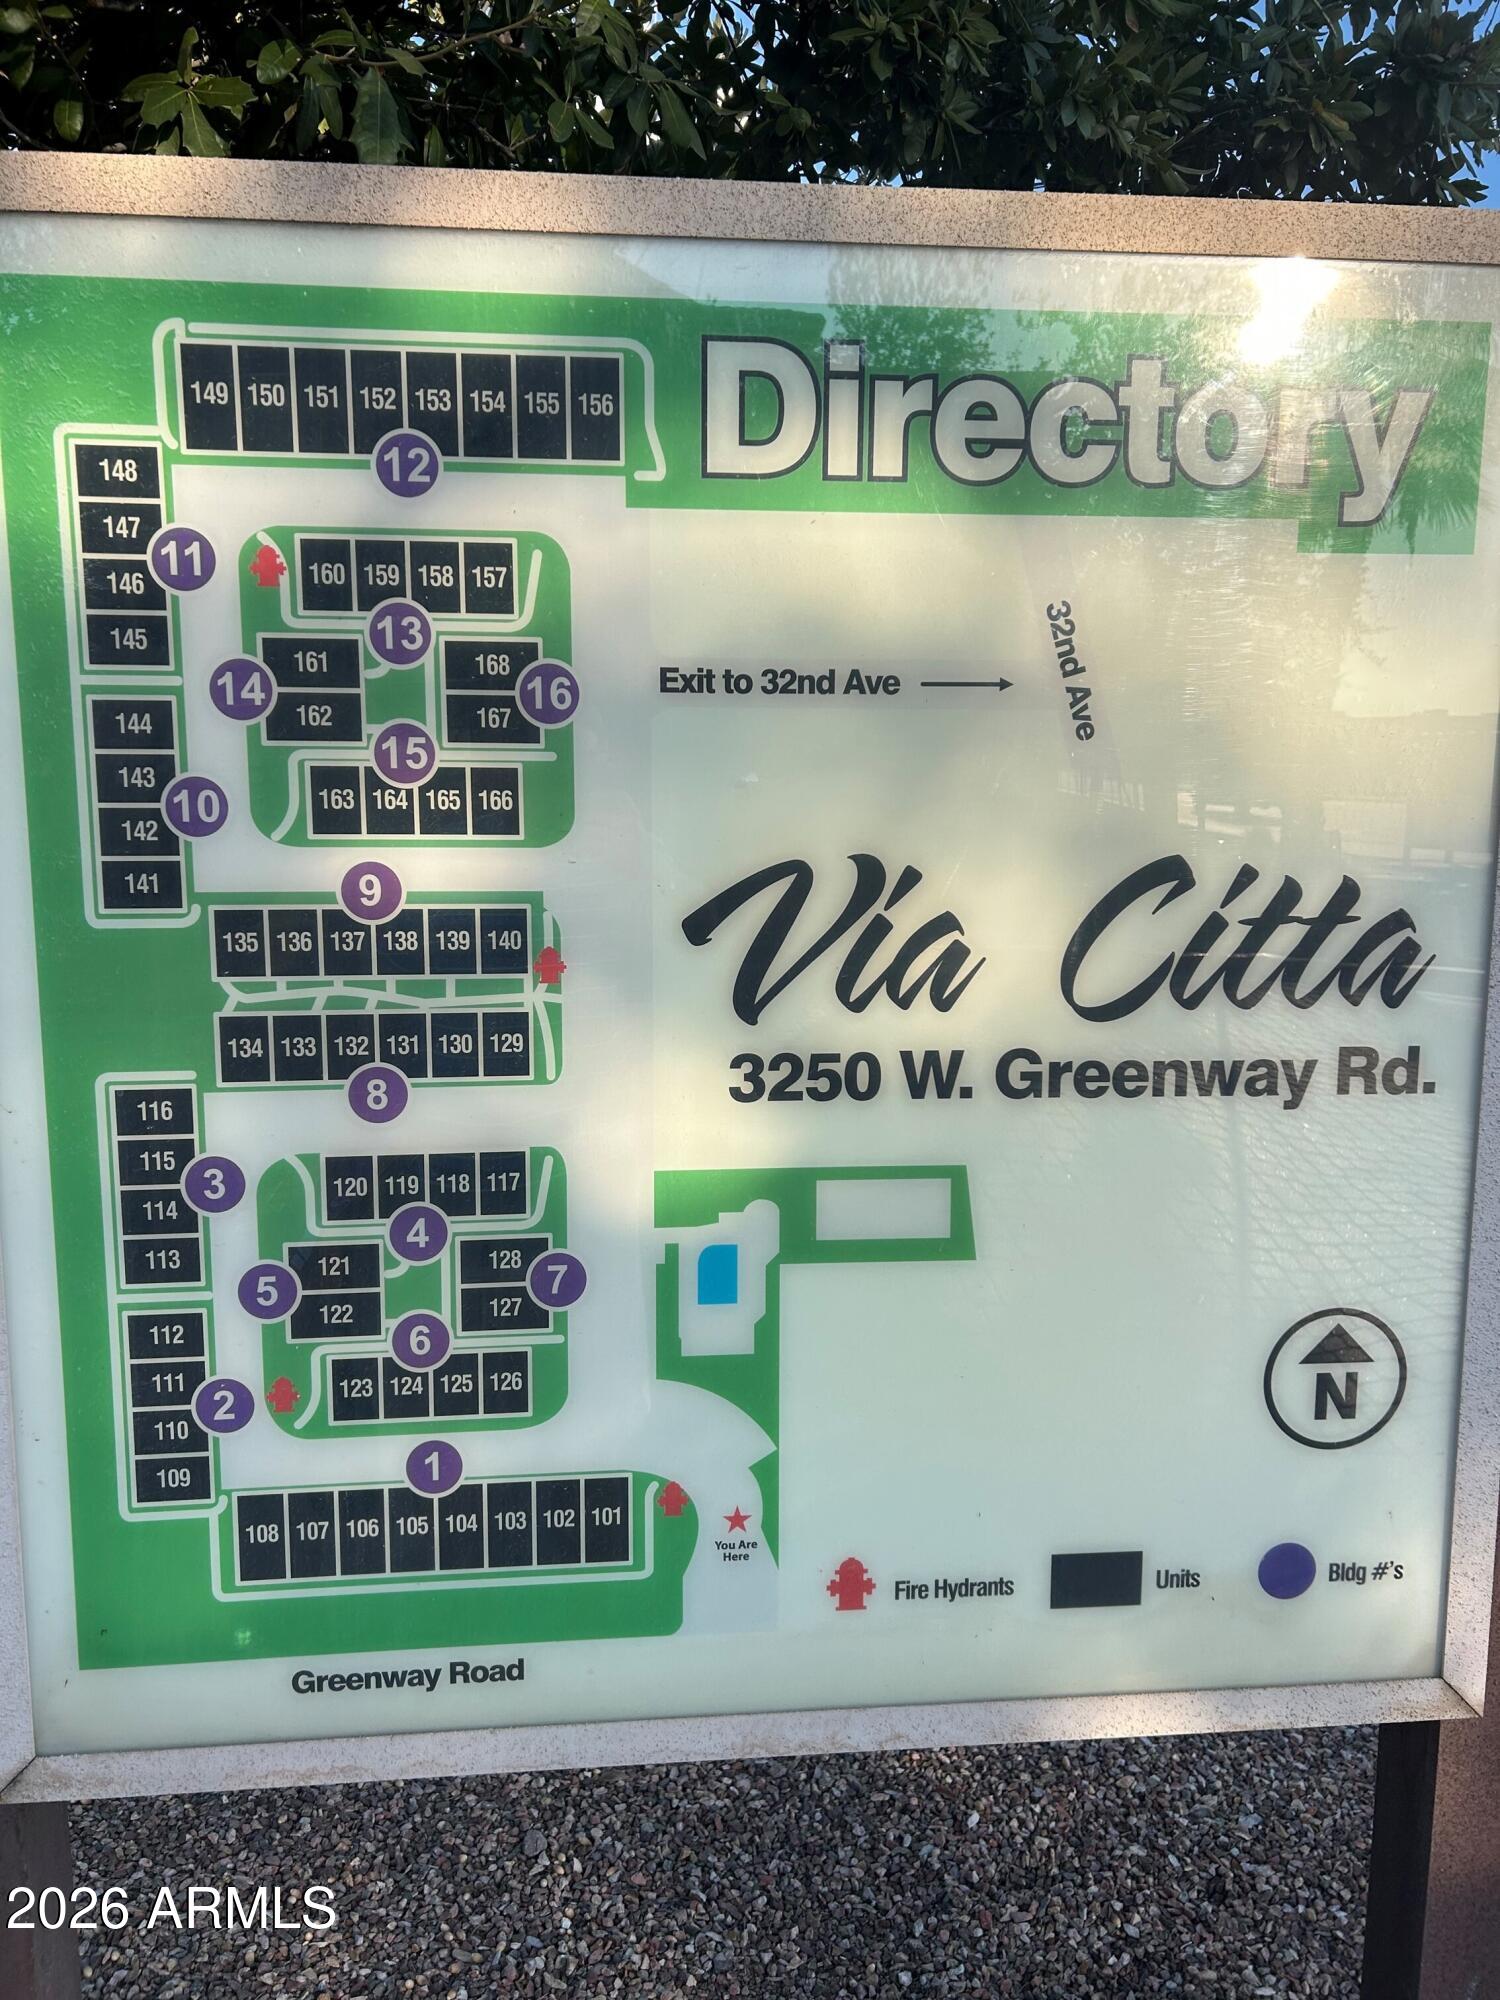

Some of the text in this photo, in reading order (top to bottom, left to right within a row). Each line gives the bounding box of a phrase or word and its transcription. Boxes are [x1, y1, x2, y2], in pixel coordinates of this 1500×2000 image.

[190, 380, 229, 405] 149
[247, 382, 285, 407] 150
[303, 384, 338, 409] 151
[359, 386, 397, 410] 152
[414, 388, 452, 412] 153
[469, 389, 506, 413] 154
[524, 391, 560, 415] 155
[578, 392, 614, 417] 156
[701, 335, 1438, 527] Directory
[98, 458, 138, 482] 148
[383, 446, 431, 483] 12
[102, 515, 141, 539] 147
[160, 540, 202, 576] 11
[106, 571, 145, 595] 146
[308, 562, 346, 585] 160
[363, 563, 400, 586] 159
[418, 564, 454, 587] 158
[471, 565, 507, 588] 157
[110, 627, 148, 650] 145
[377, 615, 424, 651] 13
[293, 650, 328, 673] 161
[474, 653, 511, 676] 168
[1046, 600, 1095, 741] 32nd Ave
[217, 671, 266, 706] 14
[659, 667, 901, 695] Exit to 32nd Ave
[527, 676, 572, 711] 16
[115, 712, 153, 734] 144
[296, 704, 333, 727] 162
[476, 707, 512, 729] 167
[381, 736, 429, 770] 15
[118, 766, 156, 788] 143
[173, 789, 220, 823] 10
[318, 788, 355, 810] 163
[372, 788, 409, 810] 164
[425, 789, 461, 811] 165
[478, 789, 513, 811] 166
[121, 820, 159, 841] 142
[124, 872, 159, 894] 141
[358, 873, 382, 907] 9
[222, 931, 259, 953] 135
[276, 931, 313, 952] 136
[330, 931, 366, 952] 137
[383, 930, 419, 951] 138
[435, 930, 471, 951] 139
[487, 930, 522, 950] 140
[681, 853, 1437, 1026] Via Citta
[227, 1037, 264, 1058] 134
[280, 1036, 317, 1057] 133
[334, 1035, 369, 1056] 132
[386, 1034, 419, 1055] 131
[438, 1033, 473, 1054] 130
[489, 1032, 524, 1053] 129
[728, 1045, 1437, 1110] 3250 W. Greenway Rd.
[366, 1078, 389, 1111] 8
[136, 1100, 173, 1121] 116
[139, 1150, 176, 1171] 115
[203, 1168, 226, 1200] 3
[333, 1176, 368, 1197] 120
[385, 1175, 419, 1196] 119
[436, 1173, 470, 1194] 118
[487, 1172, 521, 1192] 117
[142, 1200, 178, 1221] 114
[406, 1217, 430, 1248] 4
[145, 1249, 181, 1270] 113
[317, 1255, 350, 1276] 121
[488, 1249, 522, 1270] 128
[547, 1264, 568, 1295] 7
[256, 1275, 279, 1307] 5
[319, 1304, 354, 1324] 122
[489, 1297, 522, 1317] 127
[149, 1324, 185, 1345] 112
[409, 1325, 431, 1356] 6
[151, 1372, 184, 1393] 111
[339, 1378, 374, 1398] 123
[389, 1376, 424, 1396] 124
[440, 1373, 473, 1394] 125
[489, 1371, 523, 1392] 126
[213, 1390, 236, 1421] 2
[1314, 1372, 1358, 1420] N
[154, 1420, 189, 1441] 110
[424, 1451, 439, 1481] 1
[156, 1468, 191, 1488] 109
[396, 1516, 429, 1536] 105
[445, 1513, 478, 1533] 104
[494, 1511, 527, 1531] 103
[543, 1508, 575, 1528] 102
[591, 1506, 621, 1526] 101
[245, 1523, 280, 1544] 108
[295, 1521, 329, 1541] 107
[346, 1518, 380, 1538] 106
[714, 1539, 758, 1551] You Are
[722, 1552, 750, 1562] Here
[1156, 1568, 1201, 1589] Units
[1328, 1562, 1367, 1585] Bldg
[894, 1576, 1015, 1602] Fire Hydrants
[291, 1657, 525, 1694] Greenway Road
